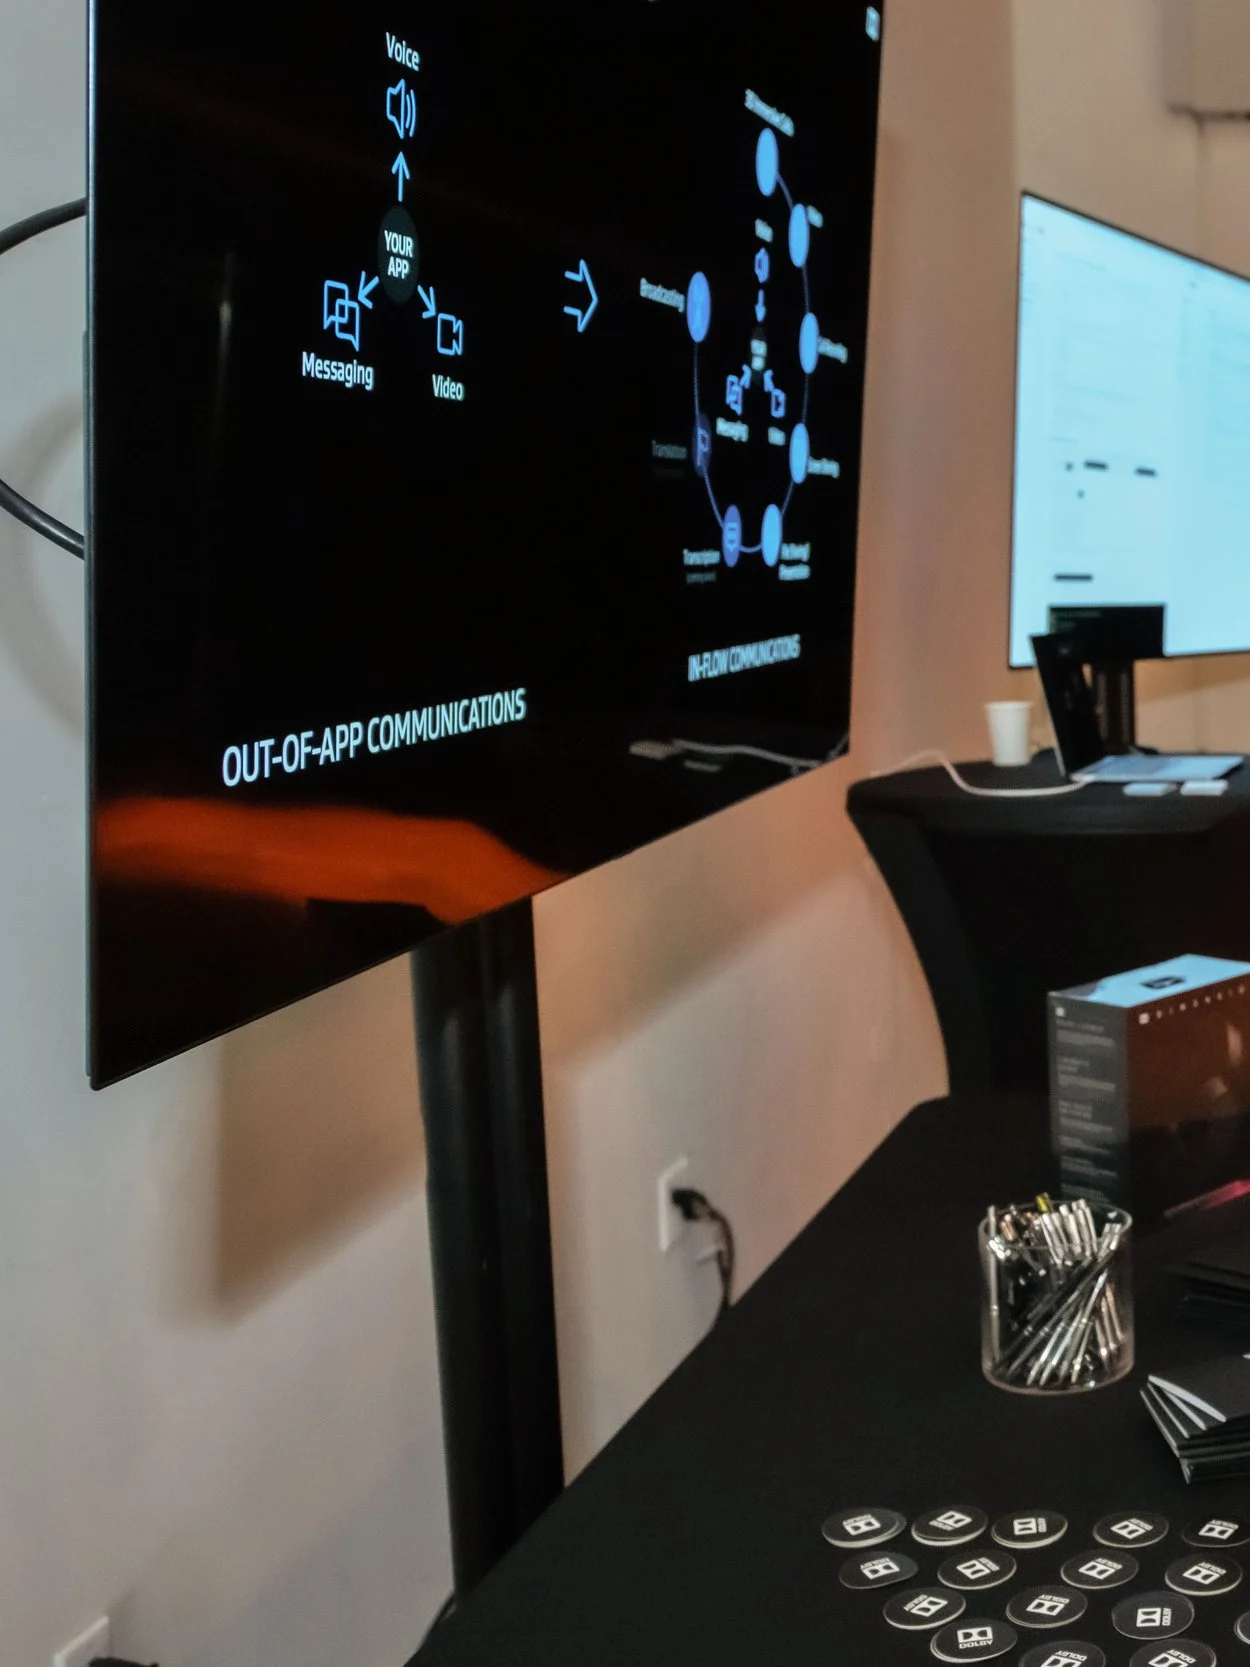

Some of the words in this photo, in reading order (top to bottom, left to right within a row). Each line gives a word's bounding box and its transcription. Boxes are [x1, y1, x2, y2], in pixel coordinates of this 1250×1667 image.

[385, 32, 420, 71] Voice
[384, 229, 413, 258] YOUR
[388, 256, 409, 279] APP
[301, 352, 374, 391] Messaging
[432, 374, 463, 400] Video
[688, 649, 728, 682] IN-FLOW
[222, 720, 362, 787] OUT-OF-APP
[367, 688, 526, 755] COMMUNICATIONS
[959, 1640, 993, 1649] DOLBY
[1055, 1650, 1088, 1662] DOLBY
[1167, 1649, 1196, 1664] DOLBY
